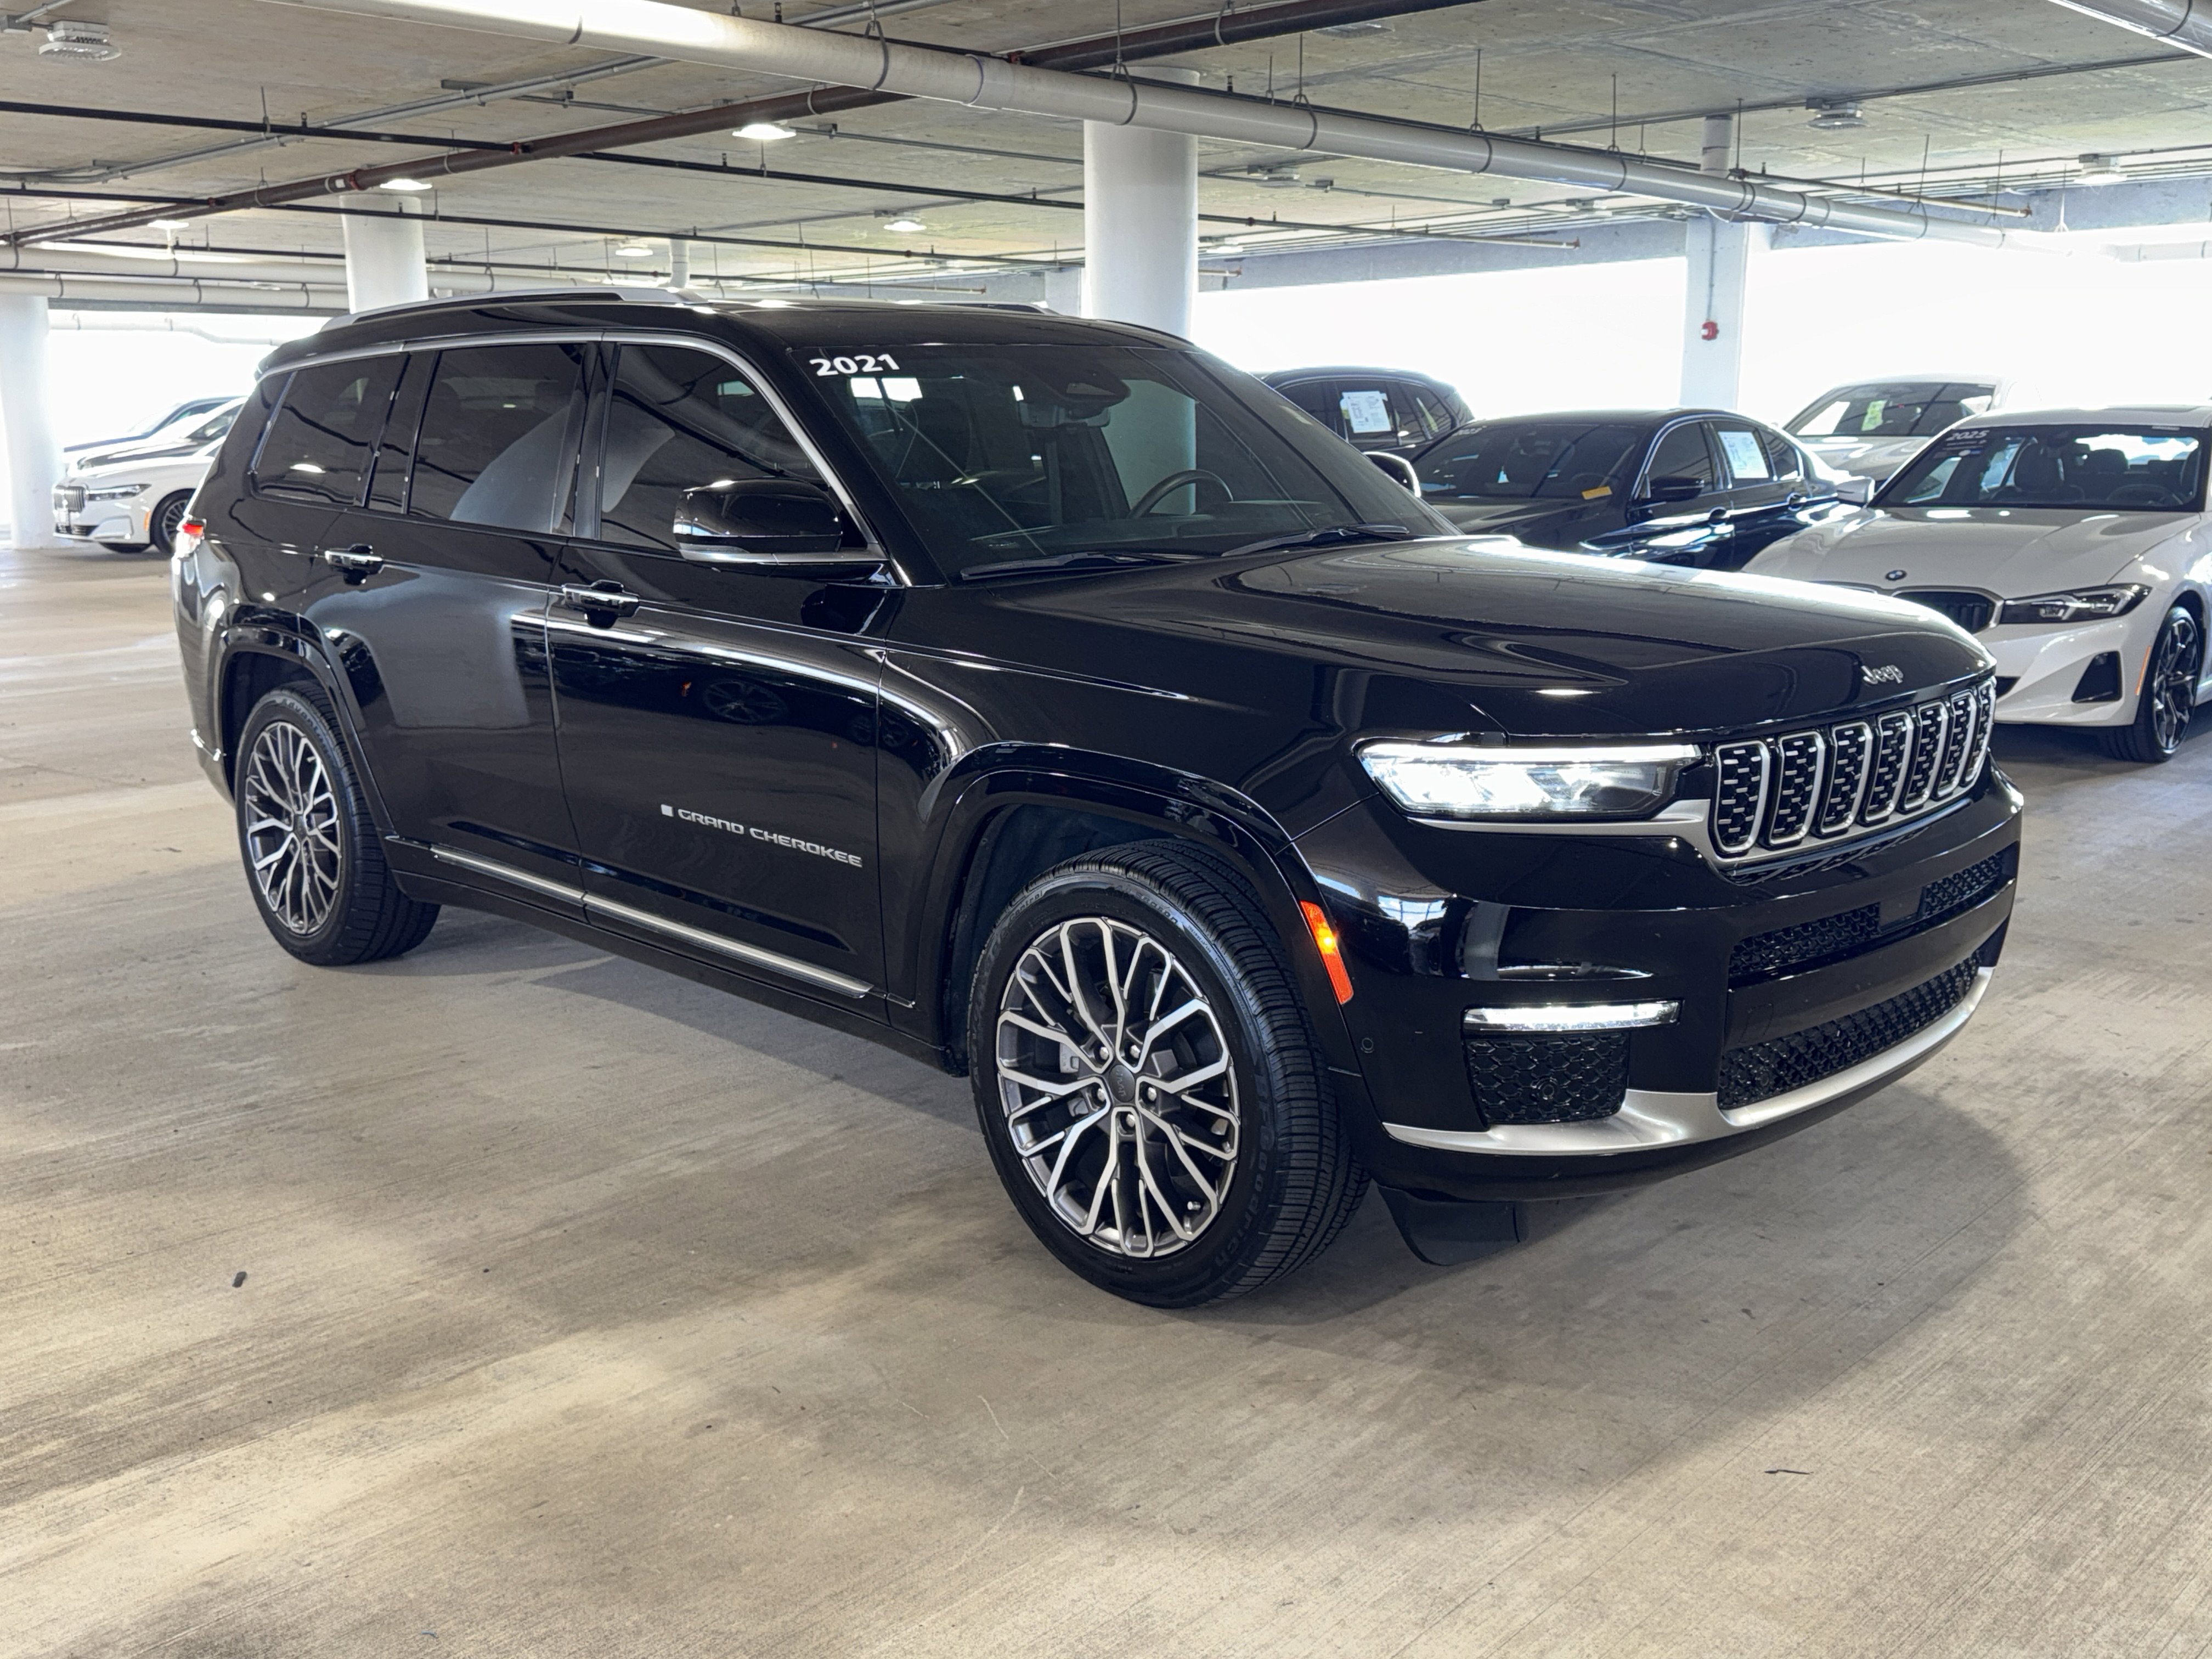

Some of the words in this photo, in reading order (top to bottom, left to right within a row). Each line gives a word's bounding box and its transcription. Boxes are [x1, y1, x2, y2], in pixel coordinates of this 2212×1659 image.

[809, 353, 900, 376] 2021
[1945, 430, 1990, 441] 2025
[1861, 664, 1904, 684] Jeep
[678, 808, 744, 835] GRAND
[749, 827, 863, 868] CHEROKEE
